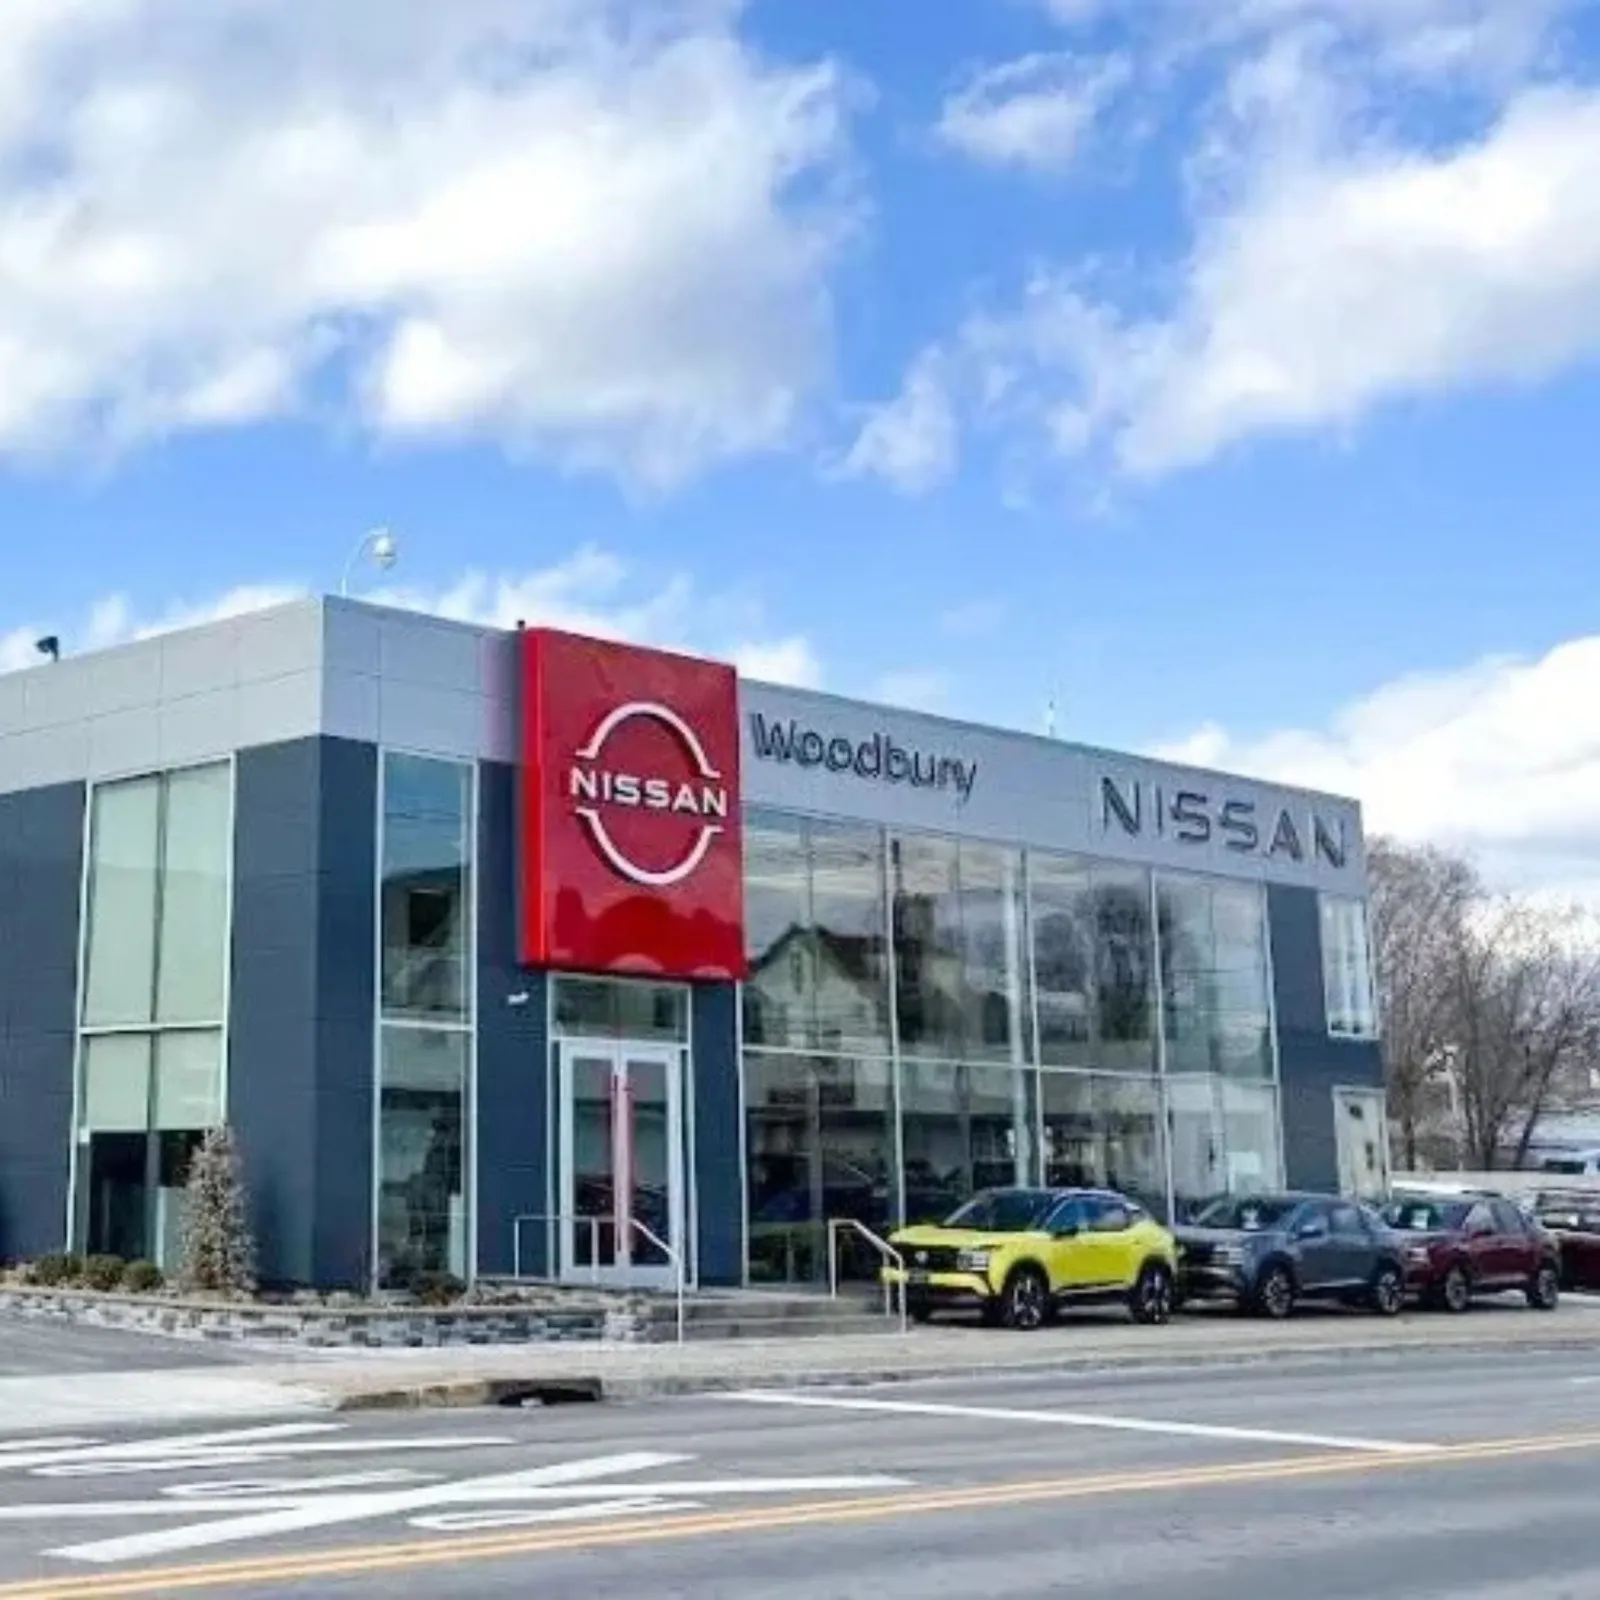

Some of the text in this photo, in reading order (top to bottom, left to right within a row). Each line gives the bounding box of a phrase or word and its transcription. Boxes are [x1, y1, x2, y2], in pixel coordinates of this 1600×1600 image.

[569, 766, 727, 817] NISSAN
[750, 713, 1347, 869] Woodbury NISSAN
